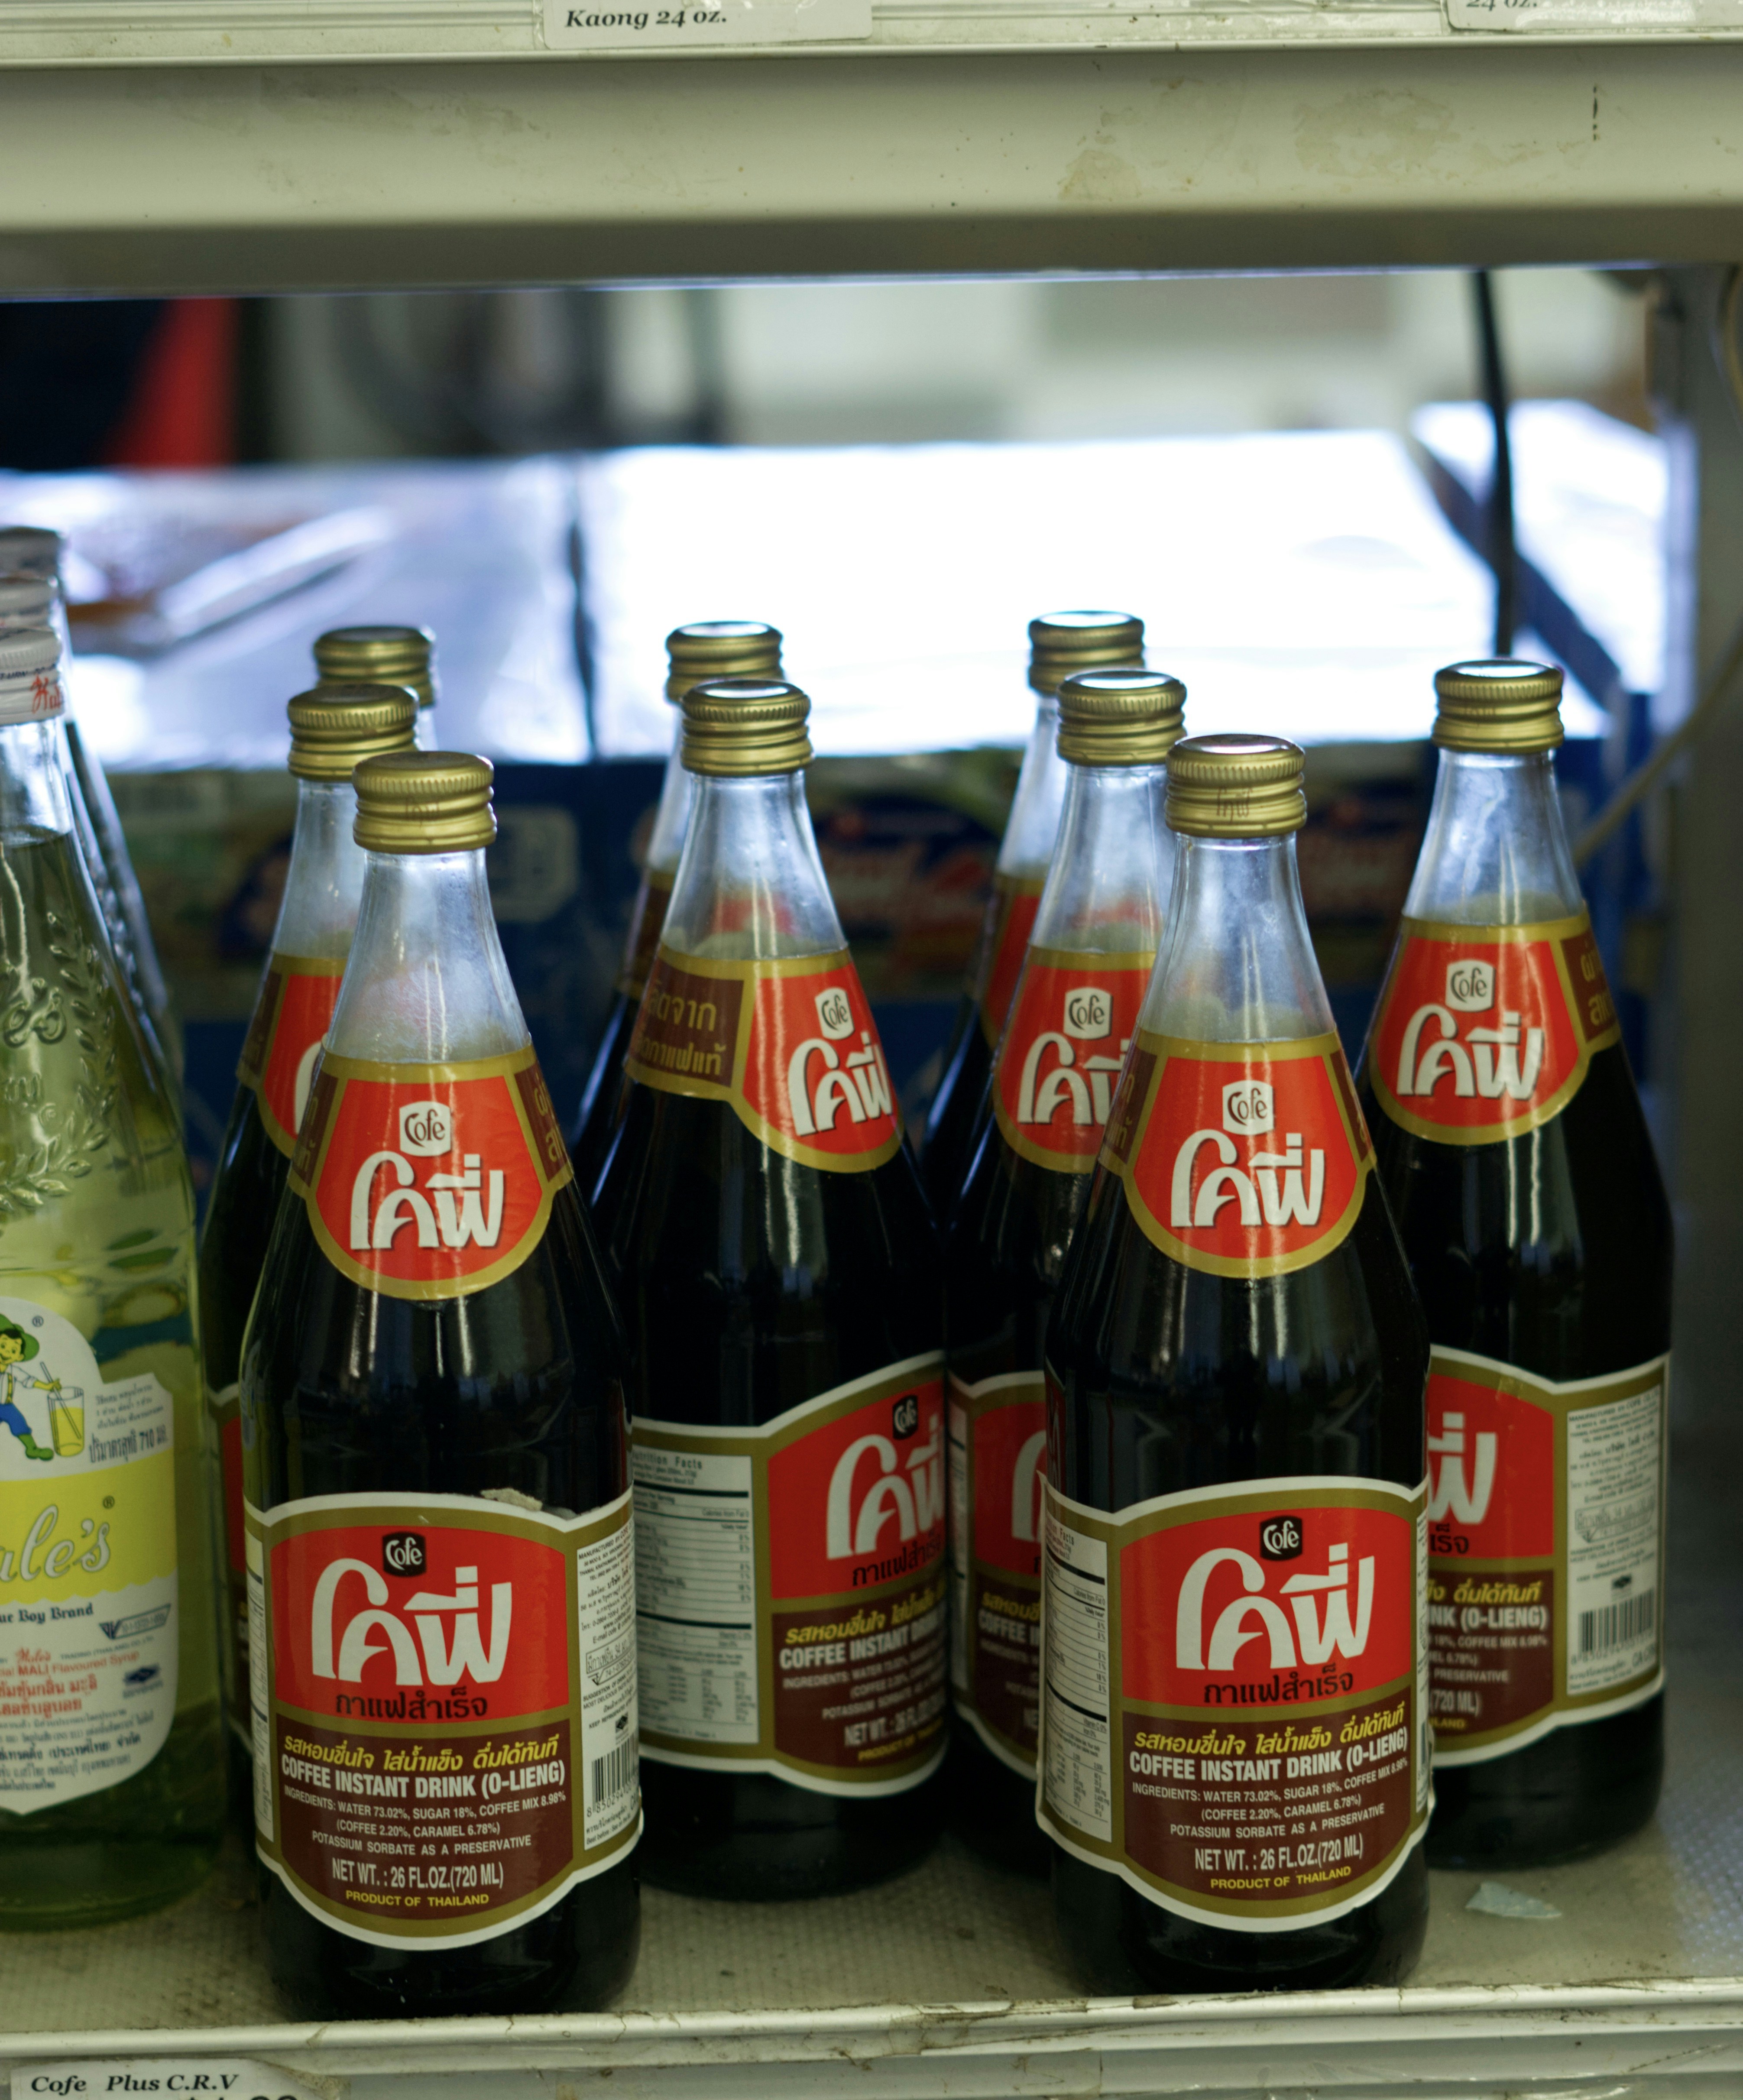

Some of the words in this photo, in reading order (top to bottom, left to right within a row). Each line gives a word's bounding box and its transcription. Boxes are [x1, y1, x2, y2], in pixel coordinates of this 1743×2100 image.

[564, 10, 648, 29] Kaong
[656, 10, 686, 27] 24
[693, 10, 727, 24] oz.
[1450, 967, 1487, 1004] Cofe
[822, 995, 848, 1031] Cofe
[1068, 995, 1105, 1031] Cofe
[1396, 1004, 1544, 1100] โคฟี่
[787, 1031, 893, 1136] โคฟี่
[1227, 1087, 1267, 1126] Cofe
[404, 1109, 446, 1147] Cofe
[1171, 1129, 1325, 1227] โคฟี่
[350, 1150, 504, 1250] โคฟี่
[386, 1535, 424, 1571] Cofe
[1262, 1519, 1301, 1555] Cofe
[18, 1609, 45, 1624] Boy
[51, 1602, 94, 1620] Brand
[311, 1558, 512, 1686] โคฟี่
[1176, 1542, 1375, 1671] โคฟี่
[1461, 1605, 1549, 1632] (O-LIENG)
[18, 1664, 49, 1676] MALI
[52, 1658, 107, 1673] Flavoured
[780, 1642, 846, 1670] COFFEE
[583, 1684, 611, 1702] SUGGESTION
[1204, 1662, 1354, 1704] กาแฟสำเร็จ
[335, 1686, 489, 1720] กาแฟสำเร็จ
[583, 1699, 597, 1710] MOST
[589, 1719, 601, 1730] KEEP
[1134, 1729, 1246, 1756] รสหอมชื่นใจ
[1256, 1725, 1332, 1755] ใส่น้ำแข็ง
[1340, 1700, 1406, 1744] ดื่มได้ทันที
[284, 1735, 376, 1769] รสหอมชื่นใจ
[383, 1745, 463, 1772] ใส่น้ำแข็ง
[473, 1733, 560, 1769] ดื่มได้ทันที
[1130, 1751, 1195, 1781] COFFEE
[1202, 1758, 1281, 1782] INSTANT
[1287, 1750, 1342, 1778] DRINK
[1346, 1726, 1407, 1773] (O-LIENG)
[282, 1753, 331, 1789] COFFEE
[335, 1769, 409, 1799] INSTANT
[415, 1773, 476, 1799] DRINK
[482, 1760, 566, 1799] (O-LIENG)
[1132, 1782, 1201, 1802] INGREDIENTS:
[1203, 1790, 1241, 1802] WATER
[1243, 1789, 1282, 1803] 73.02%,
[1284, 1785, 1320, 1800] SUGAR
[1322, 1781, 1342, 1795] 18%,
[1344, 1772, 1377, 1790] COFFEE
[1378, 1766, 1391, 1780] MIX
[1391, 1757, 1407, 1773] 8.98%
[284, 1785, 337, 1812] INGREDIENTS:
[338, 1801, 372, 1817] WATER
[373, 1805, 411, 1821] 73.02%,
[412, 1808, 450, 1819] SUGAR
[453, 1805, 477, 1819] 18%,
[479, 1799, 520, 1817] COFFEE
[522, 1794, 540, 1810] MIX
[541, 1791, 566, 1807] 8.98%
[1170, 1823, 1231, 1839] POTASSIUM
[1235, 1824, 1286, 1838] SORBATE
[1291, 1822, 1306, 1835] AS
[1310, 1820, 1318, 1832] A
[1322, 1802, 1385, 1831] PRESERVATIVE
[1202, 1807, 1247, 1821] (COFFEE
[1249, 1806, 1282, 1821] 2.20%,
[1283, 1802, 1333, 1818] CARAMEL
[1333, 1793, 1362, 1812] 6.78%)
[311, 1830, 363, 1851] POTASSIUM
[367, 1841, 415, 1855] SORBATE
[421, 1844, 436, 1856] AS
[441, 1843, 449, 1855] A
[455, 1834, 532, 1854] PRESERVATIVE
[336, 1820, 377, 1836] (COFFEE
[379, 1824, 411, 1838] 2.20%,
[413, 1825, 465, 1838] CARAMEL
[467, 1821, 500, 1837] 6.78%)
[1195, 1848, 1221, 1871] NET
[1224, 1849, 1250, 1871] WT.
[1260, 1848, 1275, 1870] 26
[1344, 1833, 1364, 1860] ML)
[332, 1857, 355, 1882] NET
[358, 1860, 380, 1886] WT.
[391, 1865, 406, 1888] 26
[480, 1862, 504, 1888] ML)
[1211, 1878, 1271, 1889] PRODUCT
[1274, 1876, 1290, 1888] OF
[1296, 1865, 1352, 1885] THAILAND
[346, 1890, 402, 1906] PRODUCT
[405, 1896, 421, 1907] OF
[428, 1894, 489, 1906] THAILAND
[31, 2075, 87, 2096] Cofe
[106, 2074, 160, 2091] Plus
[167, 2074, 239, 2091] C.R.V
